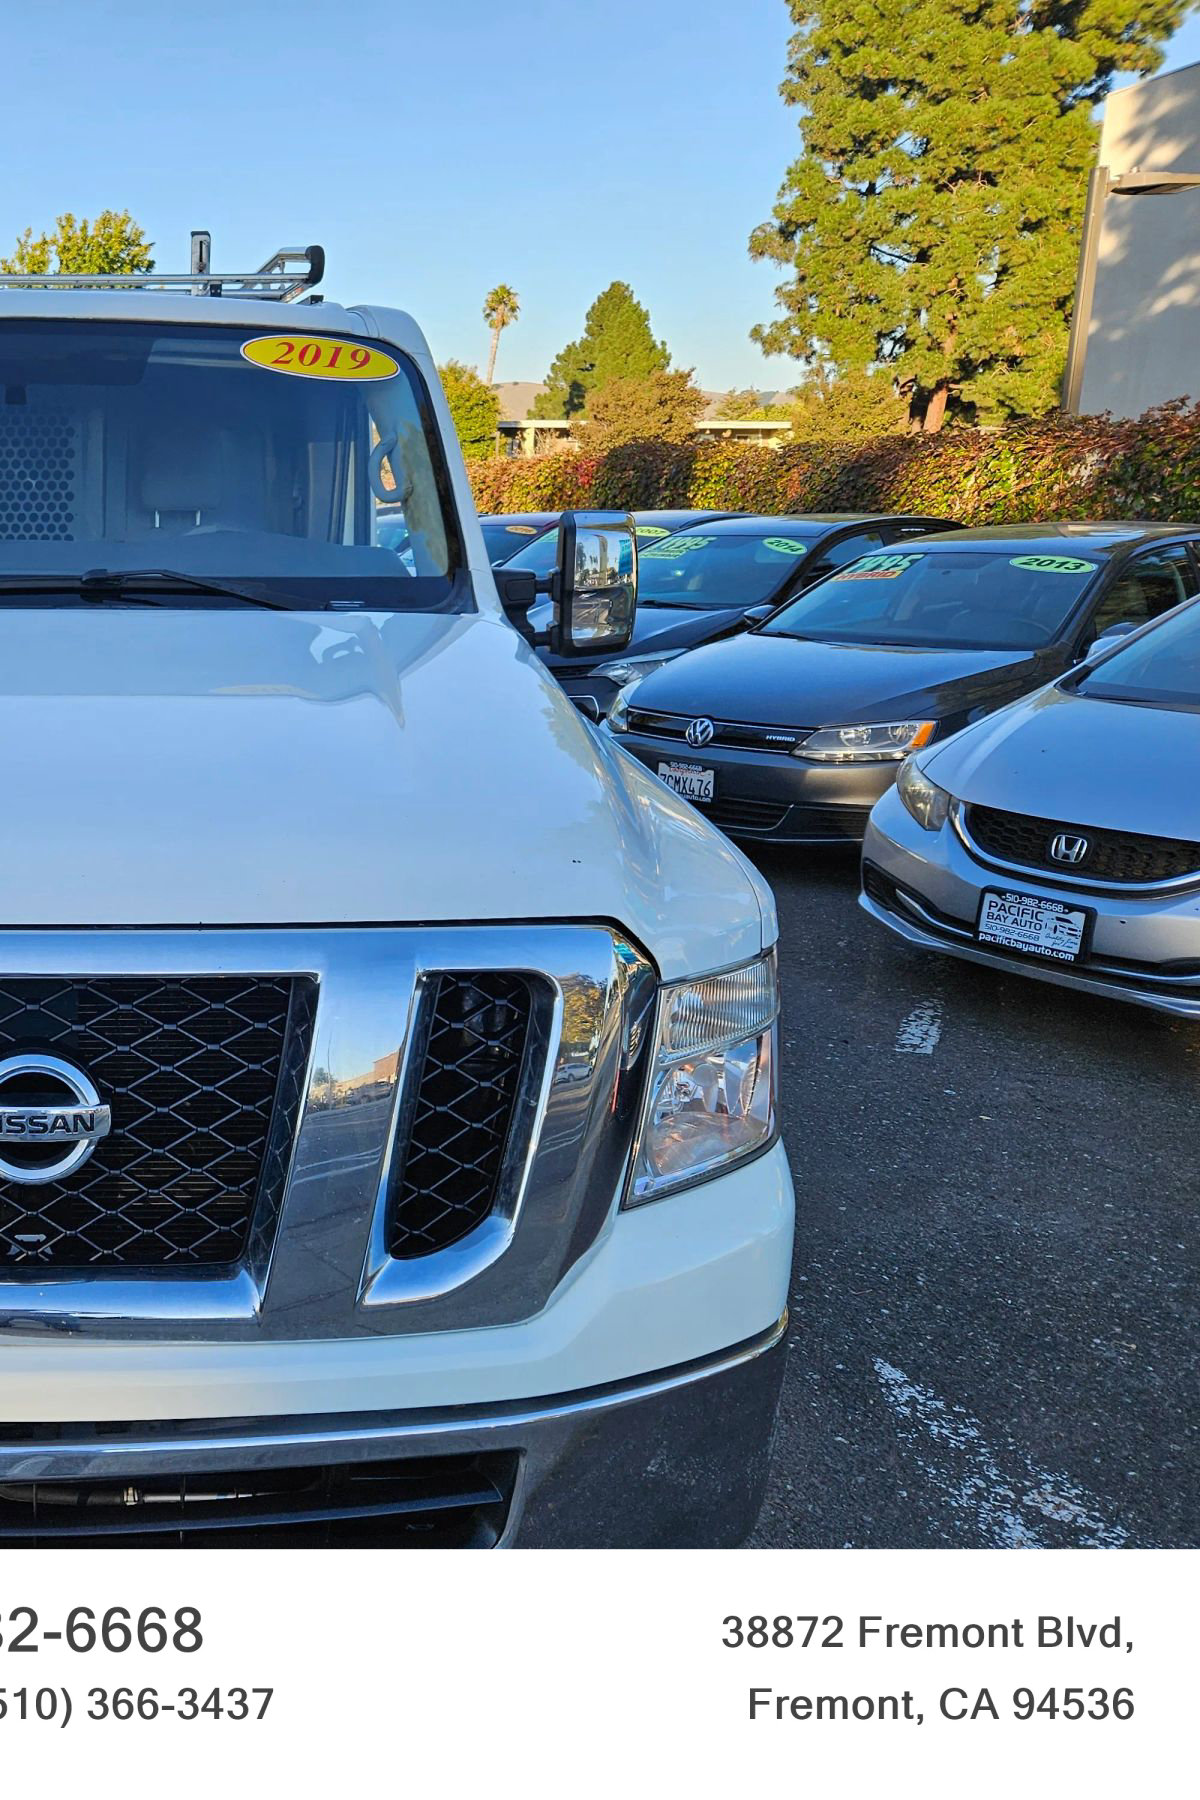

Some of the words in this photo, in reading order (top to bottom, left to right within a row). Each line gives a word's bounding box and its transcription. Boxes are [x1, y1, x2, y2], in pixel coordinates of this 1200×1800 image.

[270, 341, 371, 370] 2019
[769, 539, 802, 554] 2014
[1018, 557, 1087, 571] 2013
[765, 734, 796, 742] HYBRID
[988, 900, 1045, 922] PACIFIC
[986, 912, 1009, 923] BAY
[1011, 917, 1043, 931] AUTO
[978, 932, 1075, 962] pacificbayauto.com
